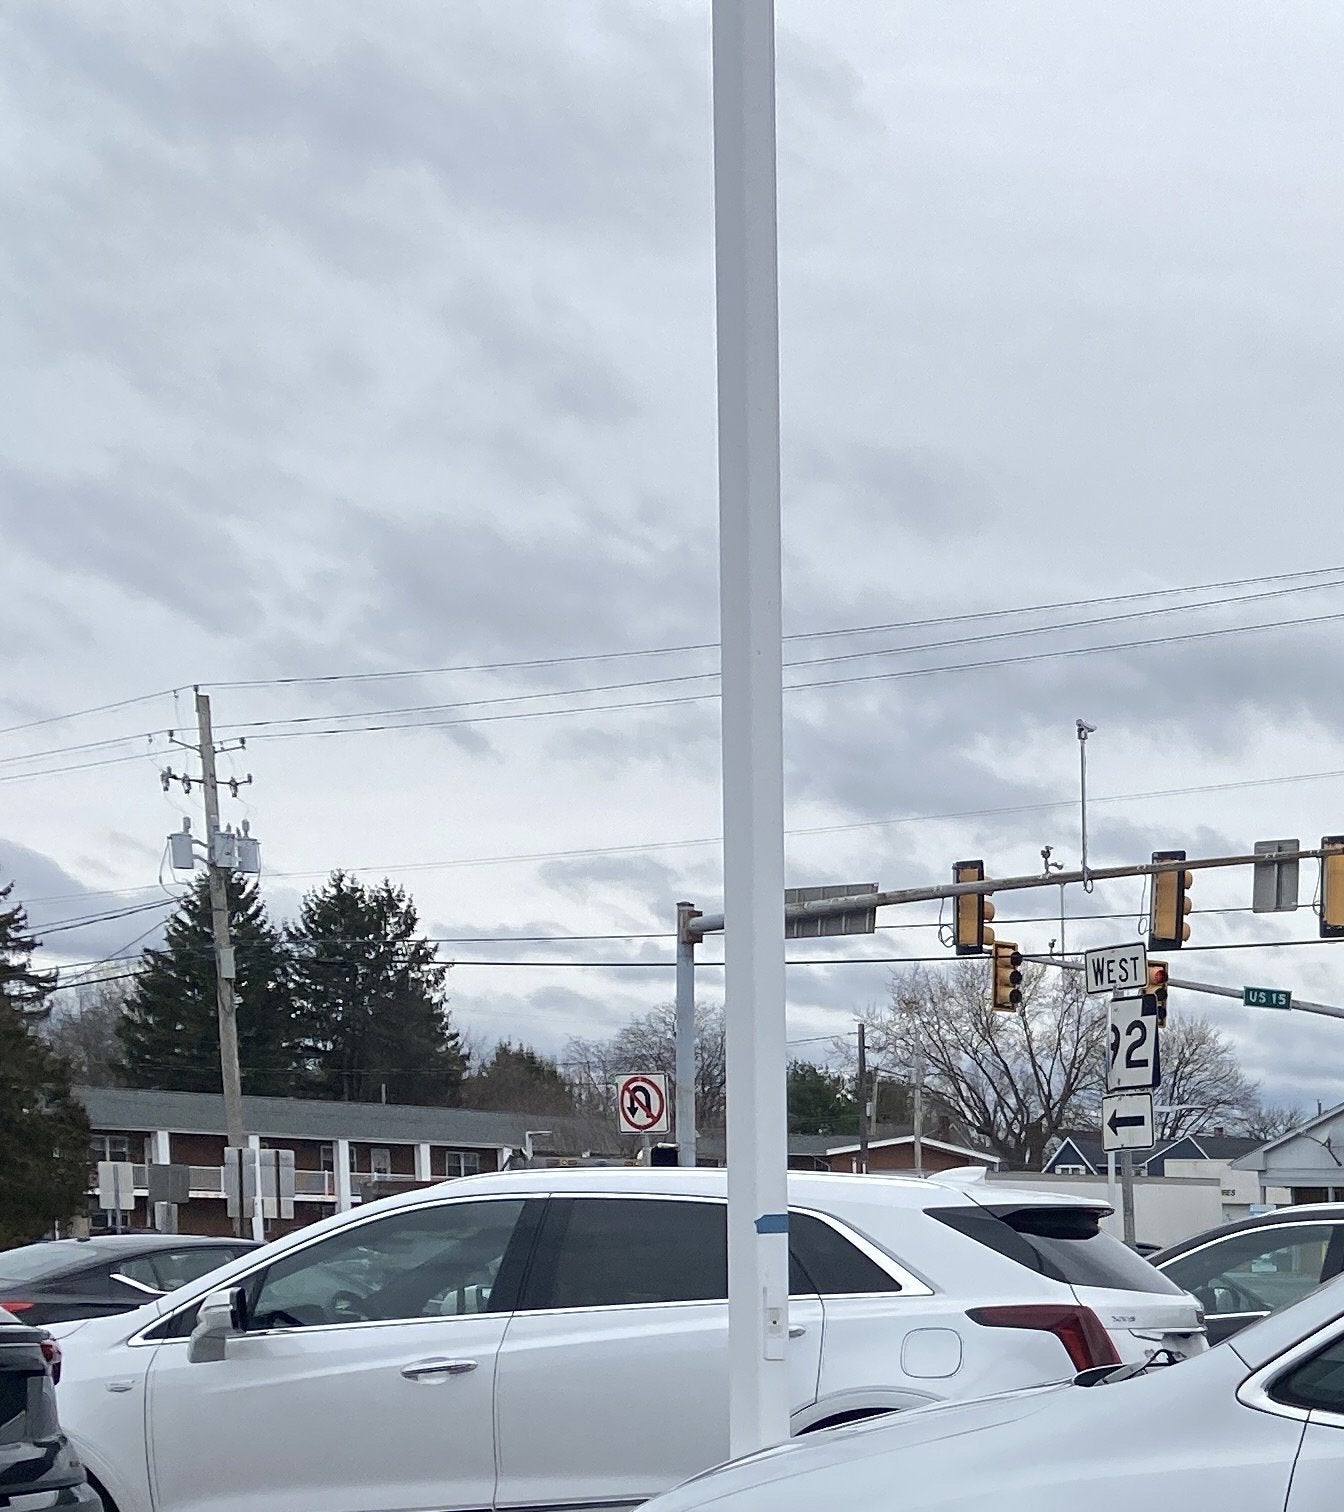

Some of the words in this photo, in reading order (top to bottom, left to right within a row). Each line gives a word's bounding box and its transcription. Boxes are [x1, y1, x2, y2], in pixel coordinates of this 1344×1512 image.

[1092, 956, 1139, 987] WEST
[1249, 990, 1267, 1004] US
[1271, 992, 1287, 1006] 15
